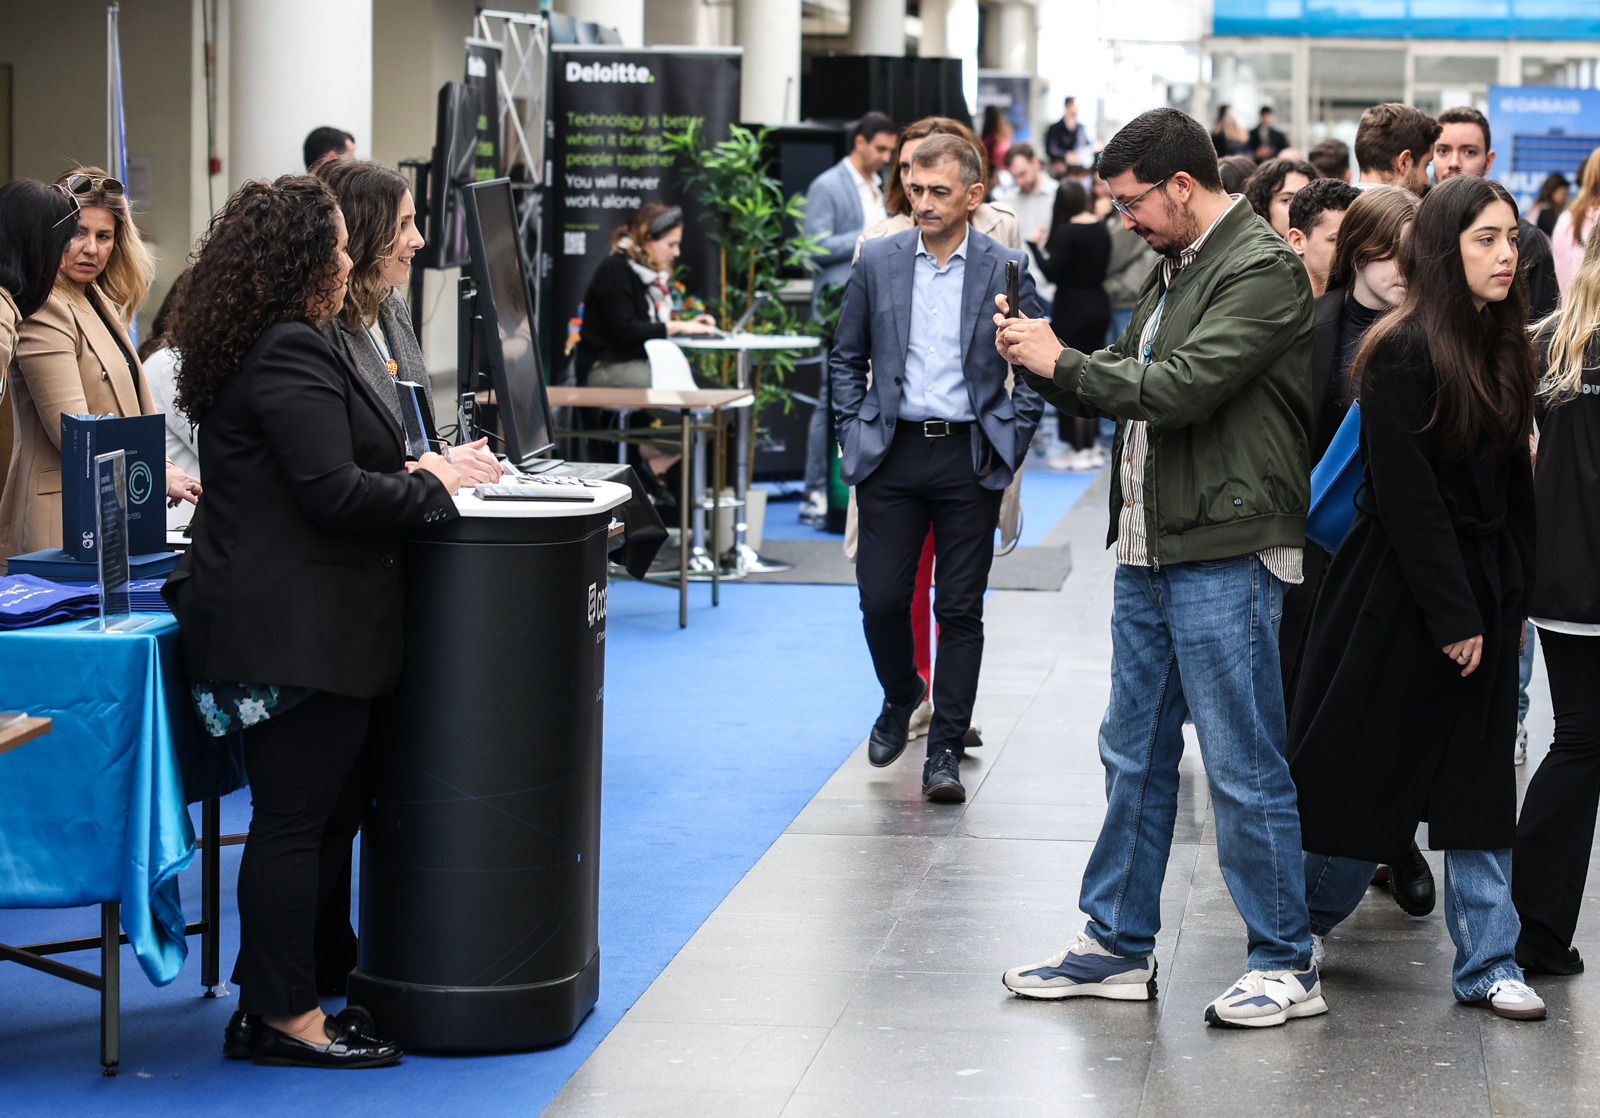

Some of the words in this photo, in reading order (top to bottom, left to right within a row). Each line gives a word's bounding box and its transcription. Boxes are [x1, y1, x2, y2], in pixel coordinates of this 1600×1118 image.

[566, 61, 655, 83] Deloitte.
[567, 112, 645, 131] Technology
[647, 113, 660, 128] is
[566, 132, 605, 146] when
[607, 133, 617, 146] it
[620, 133, 663, 151] brings
[565, 151, 614, 169] people
[617, 152, 675, 170] together
[565, 173, 593, 189] You
[595, 173, 618, 189] will
[620, 175, 660, 190] never
[565, 193, 600, 208] work
[602, 193, 641, 209] alone
